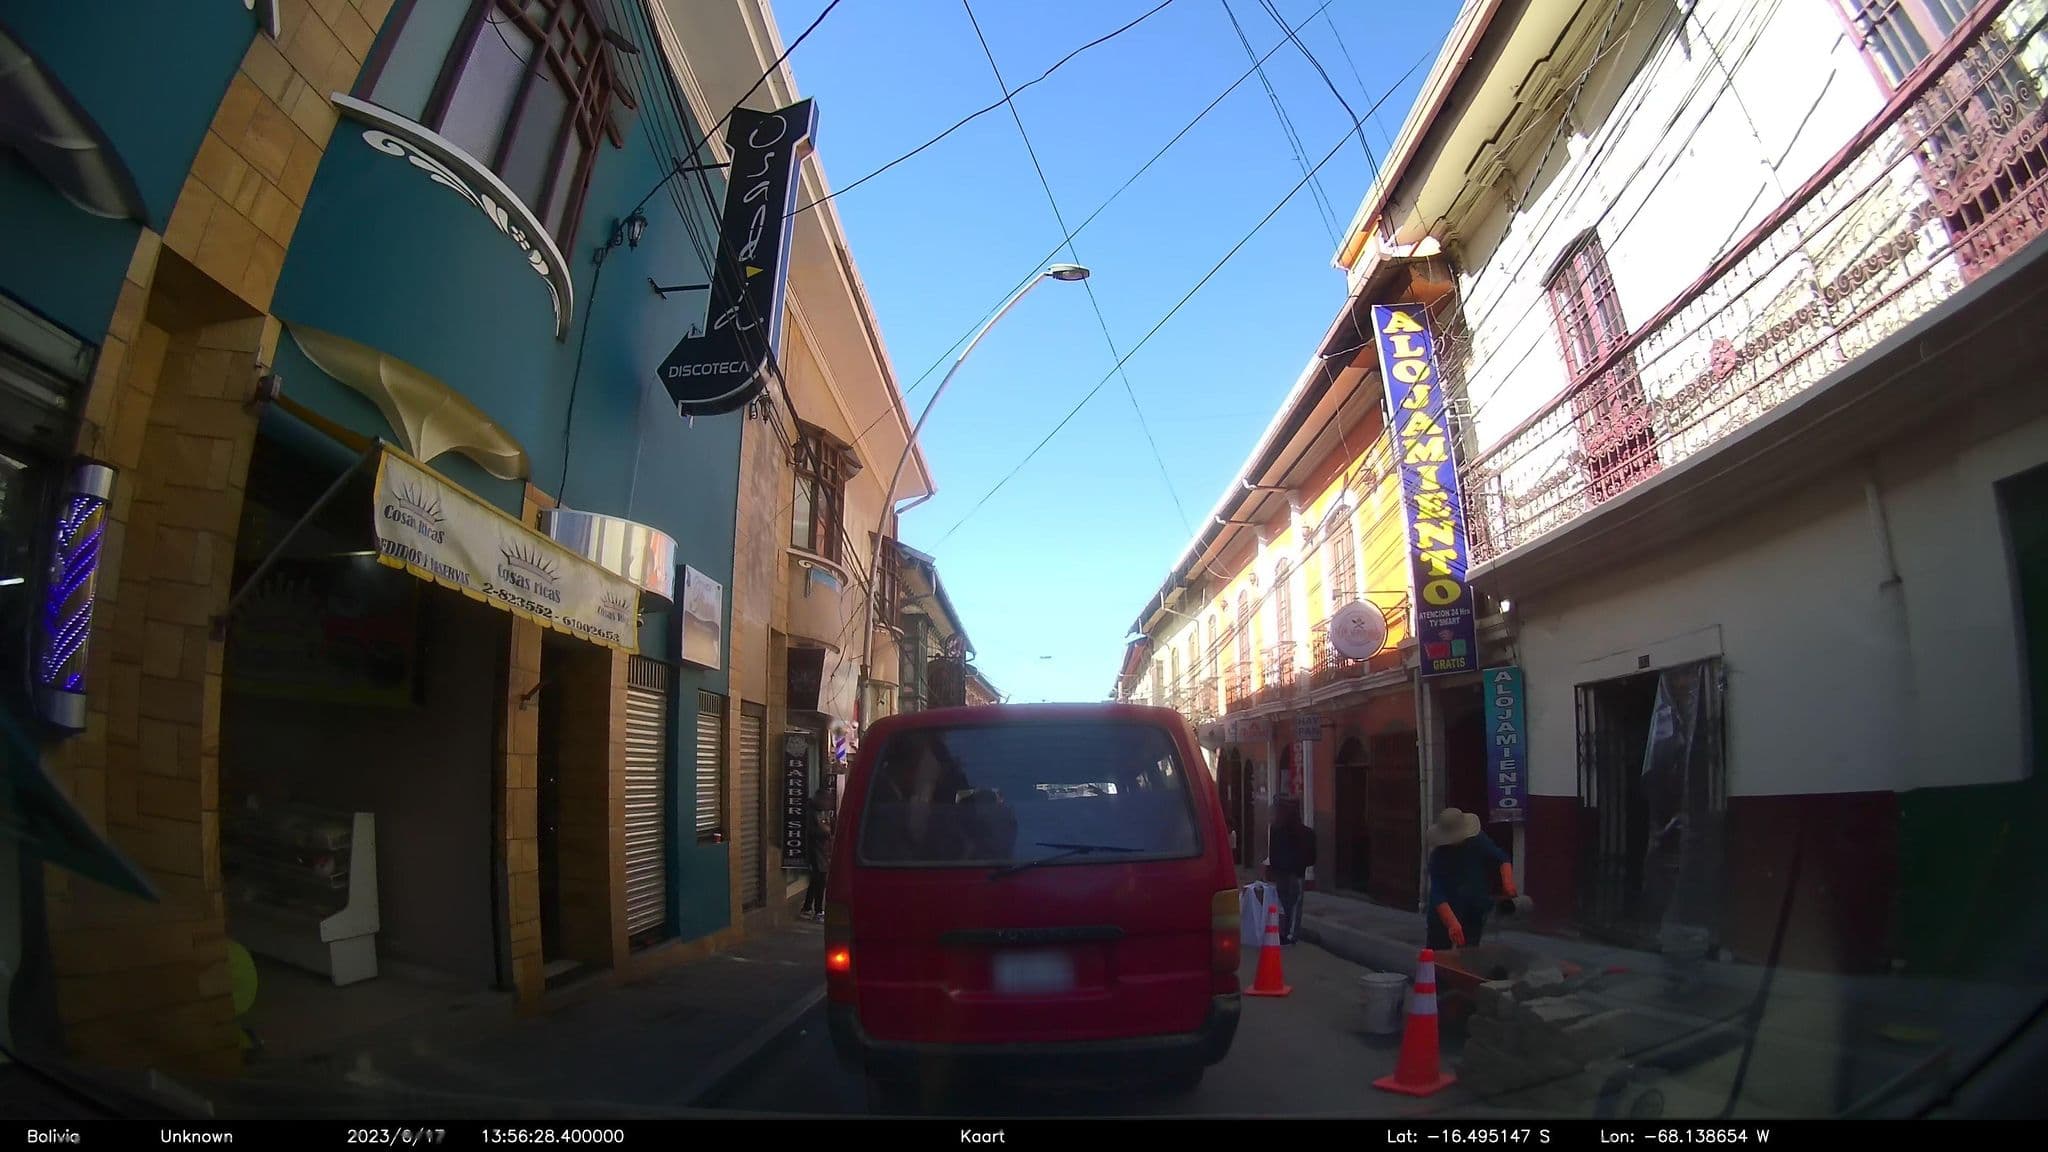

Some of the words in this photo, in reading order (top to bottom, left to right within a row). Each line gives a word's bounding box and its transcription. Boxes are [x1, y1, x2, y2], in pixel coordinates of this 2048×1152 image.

[668, 360, 750, 378] DISCOTECA
[1382, 311, 1461, 605] ALOJAMIENTO
[381, 537, 422, 564] EDIDOS
[1429, 619, 1438, 627] TV
[1433, 657, 1466, 670] GRATIS
[1494, 671, 1519, 808] ALOJAMIENTO
[787, 759, 802, 815] BARBER
[786, 821, 802, 856] SHOP
